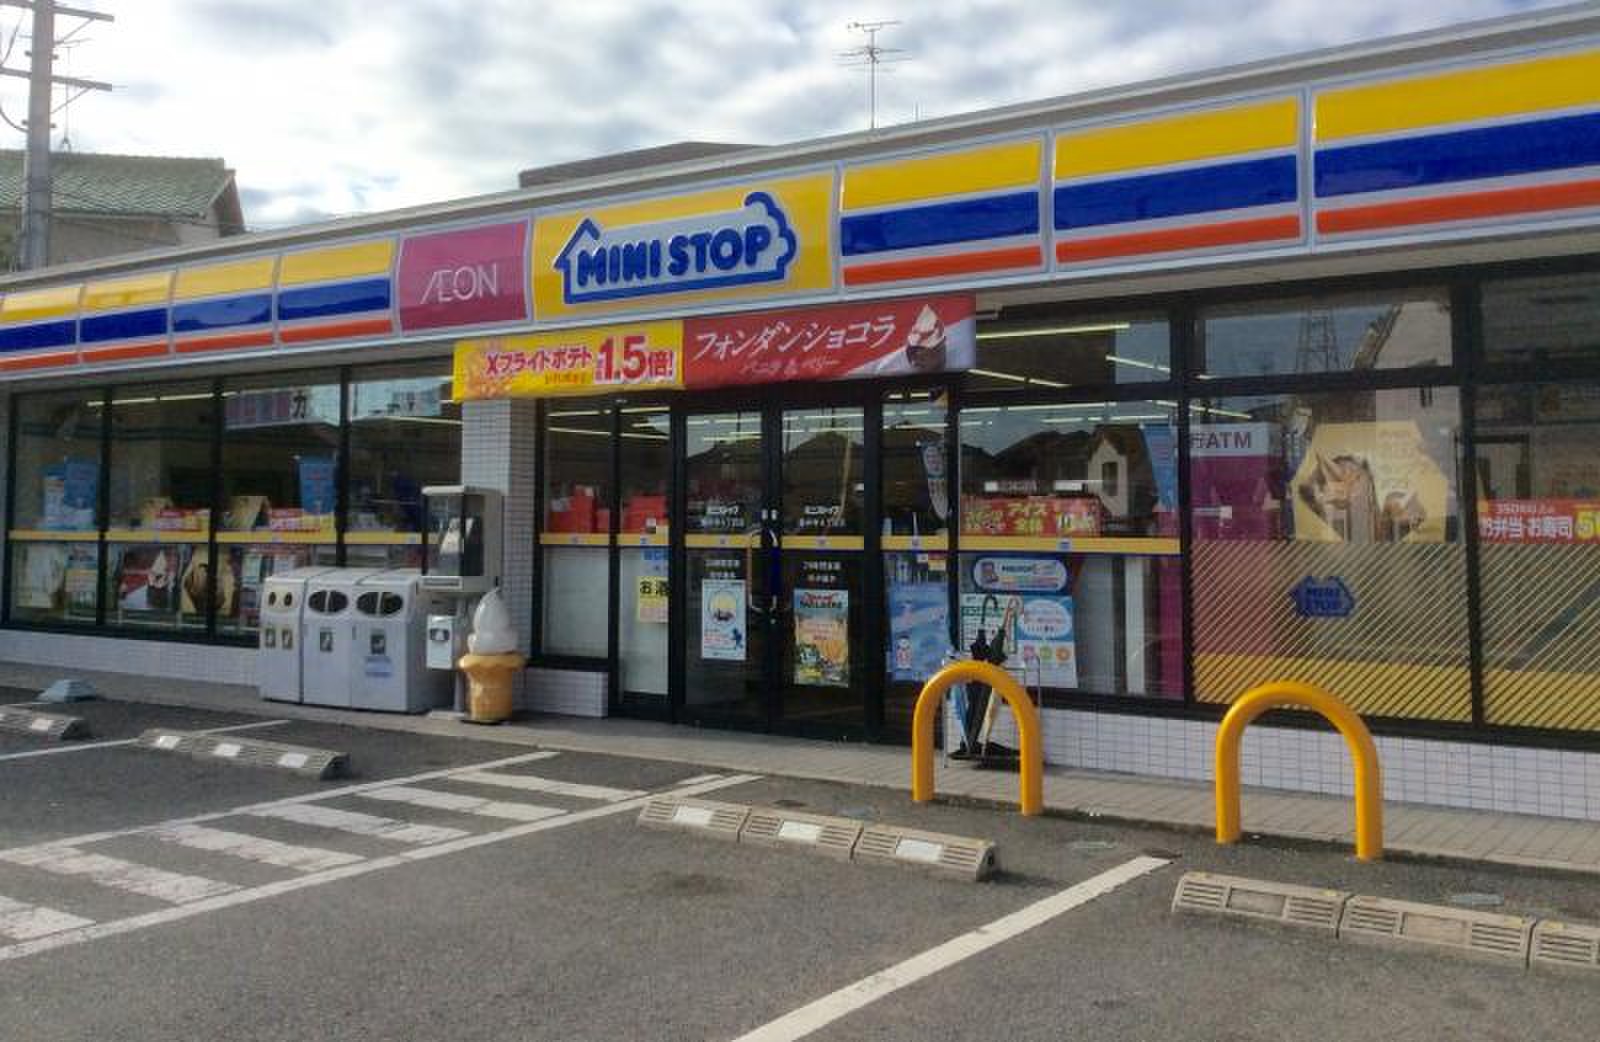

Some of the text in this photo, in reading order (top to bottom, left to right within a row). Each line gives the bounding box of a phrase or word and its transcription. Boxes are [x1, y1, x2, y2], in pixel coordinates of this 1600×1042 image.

[576, 224, 773, 288] MINI STOP
[693, 315, 897, 361] フォンダンショコラ
